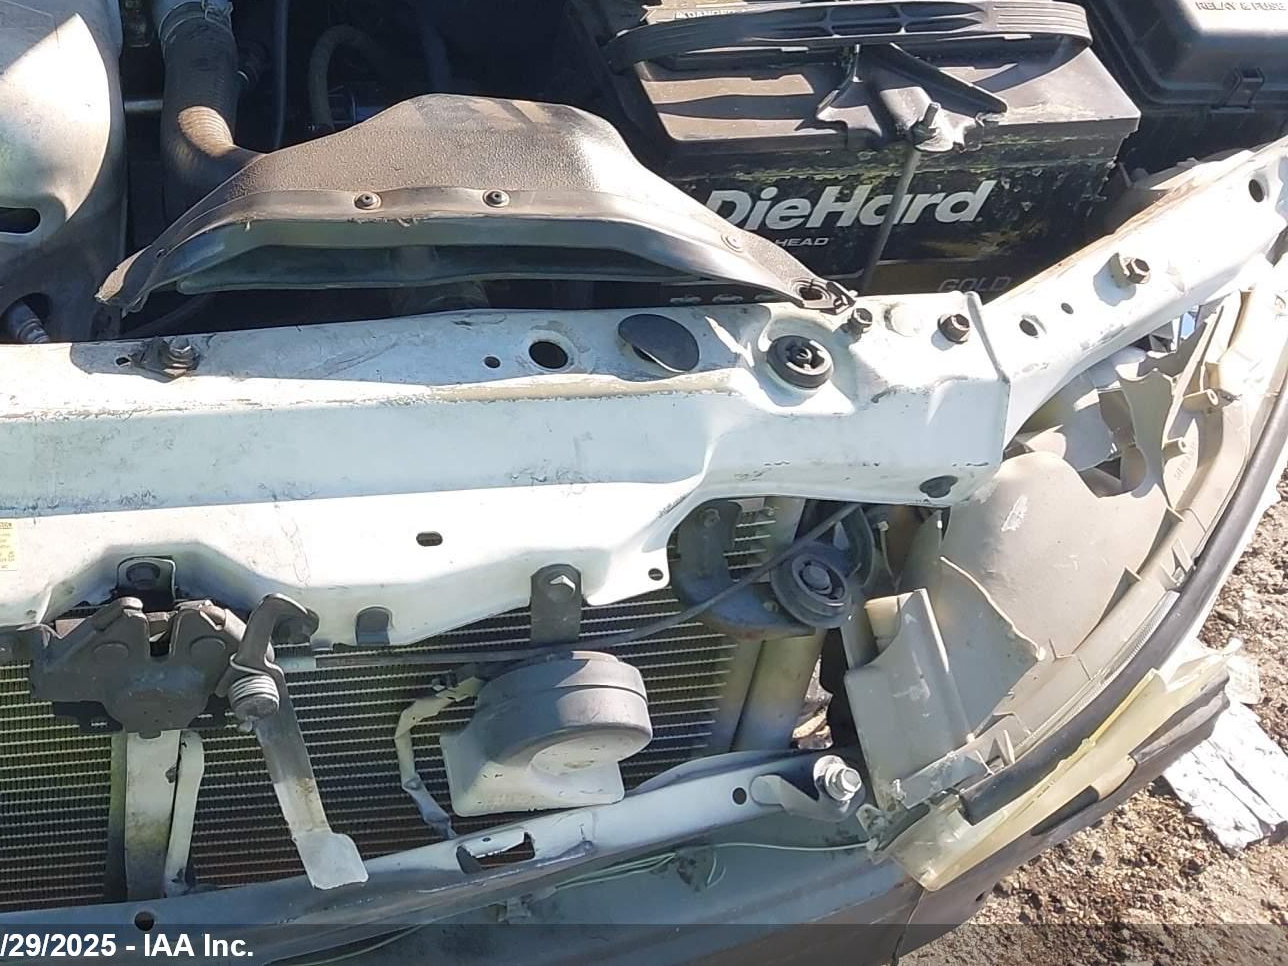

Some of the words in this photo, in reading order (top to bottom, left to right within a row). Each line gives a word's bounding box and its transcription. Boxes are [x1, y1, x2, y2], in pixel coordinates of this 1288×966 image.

[1194, 1, 1238, 11] RELAY
[705, 180, 998, 231] DieHard
[937, 275, 1012, 292] GOLD
